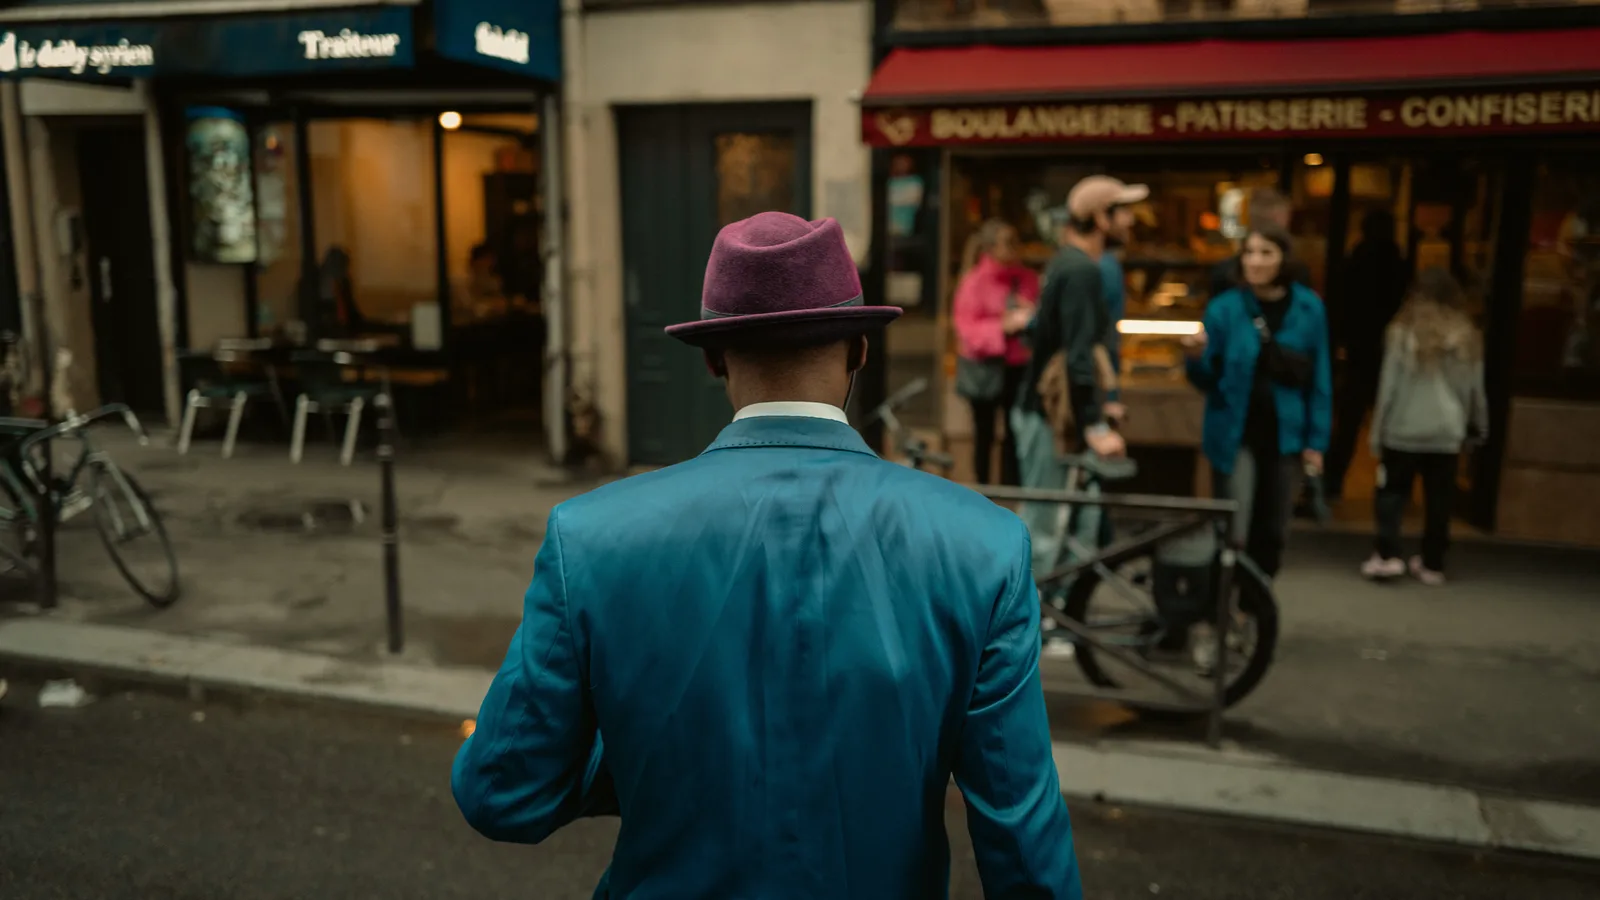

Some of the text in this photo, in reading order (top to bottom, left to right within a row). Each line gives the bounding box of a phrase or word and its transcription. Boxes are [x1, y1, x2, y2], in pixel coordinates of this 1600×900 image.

[298, 28, 400, 59] Traiteur
[931, 102, 1153, 139] BOULANGERIE
[1175, 97, 1368, 132] PATISSERIE
[1401, 89, 1600, 128] CONFISERI
